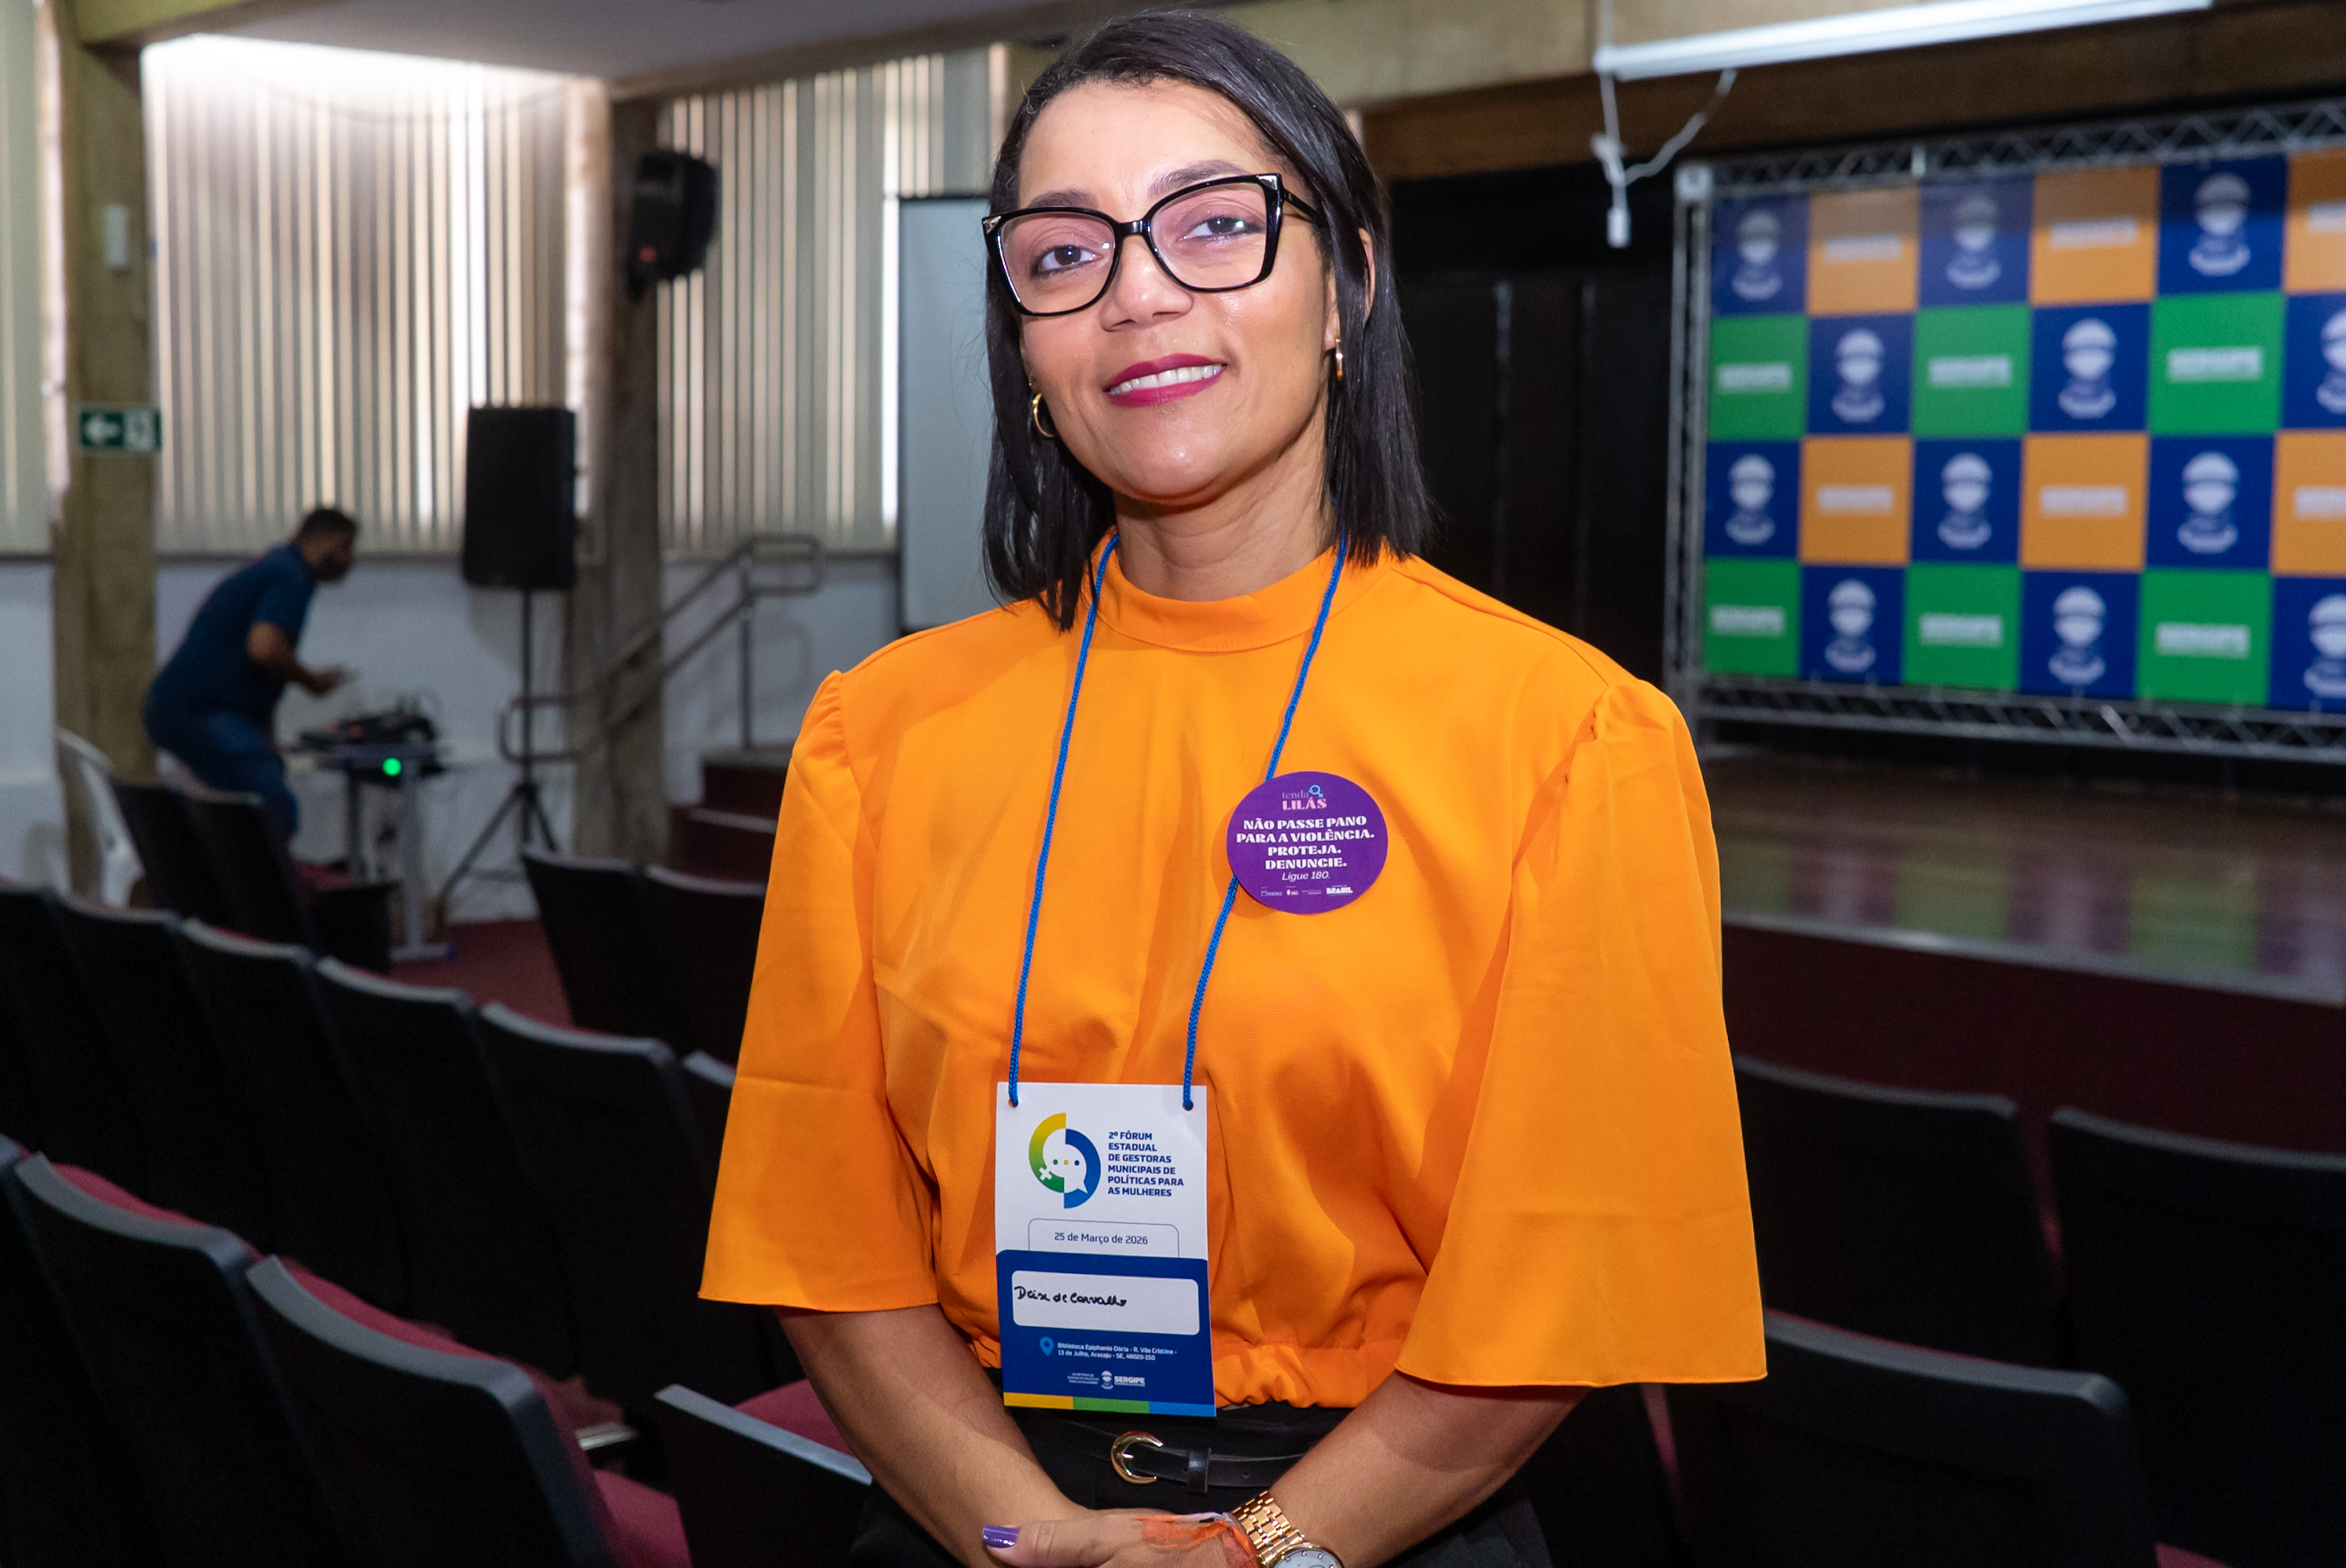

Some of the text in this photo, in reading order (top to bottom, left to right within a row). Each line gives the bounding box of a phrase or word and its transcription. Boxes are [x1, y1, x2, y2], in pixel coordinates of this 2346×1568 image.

[1282, 790, 1309, 799] tenda
[1282, 797, 1328, 810] LILÁS
[1244, 816, 1367, 829] NÃO PASSE PANO
[1236, 829, 1375, 843] PARA A VIOLÊNCIA.
[1268, 845, 1342, 857] PROTEJA.
[1265, 857, 1348, 869] DENUNCIE.
[1281, 871, 1331, 882] Ligue 180.
[1120, 1130, 1153, 1140] FÓRUM
[1108, 1143, 1158, 1152] ESTADUAL
[1122, 1154, 1172, 1163] GESTORAS
[1108, 1165, 1162, 1174] MUNICIPAIS
[1108, 1174, 1184, 1186] POLÍTICAS PARA
[1122, 1187, 1172, 1197] MULHERES
[1054, 1232, 1148, 1245] 25 de Março de 2026
[1053, 1292, 1068, 1303] de
